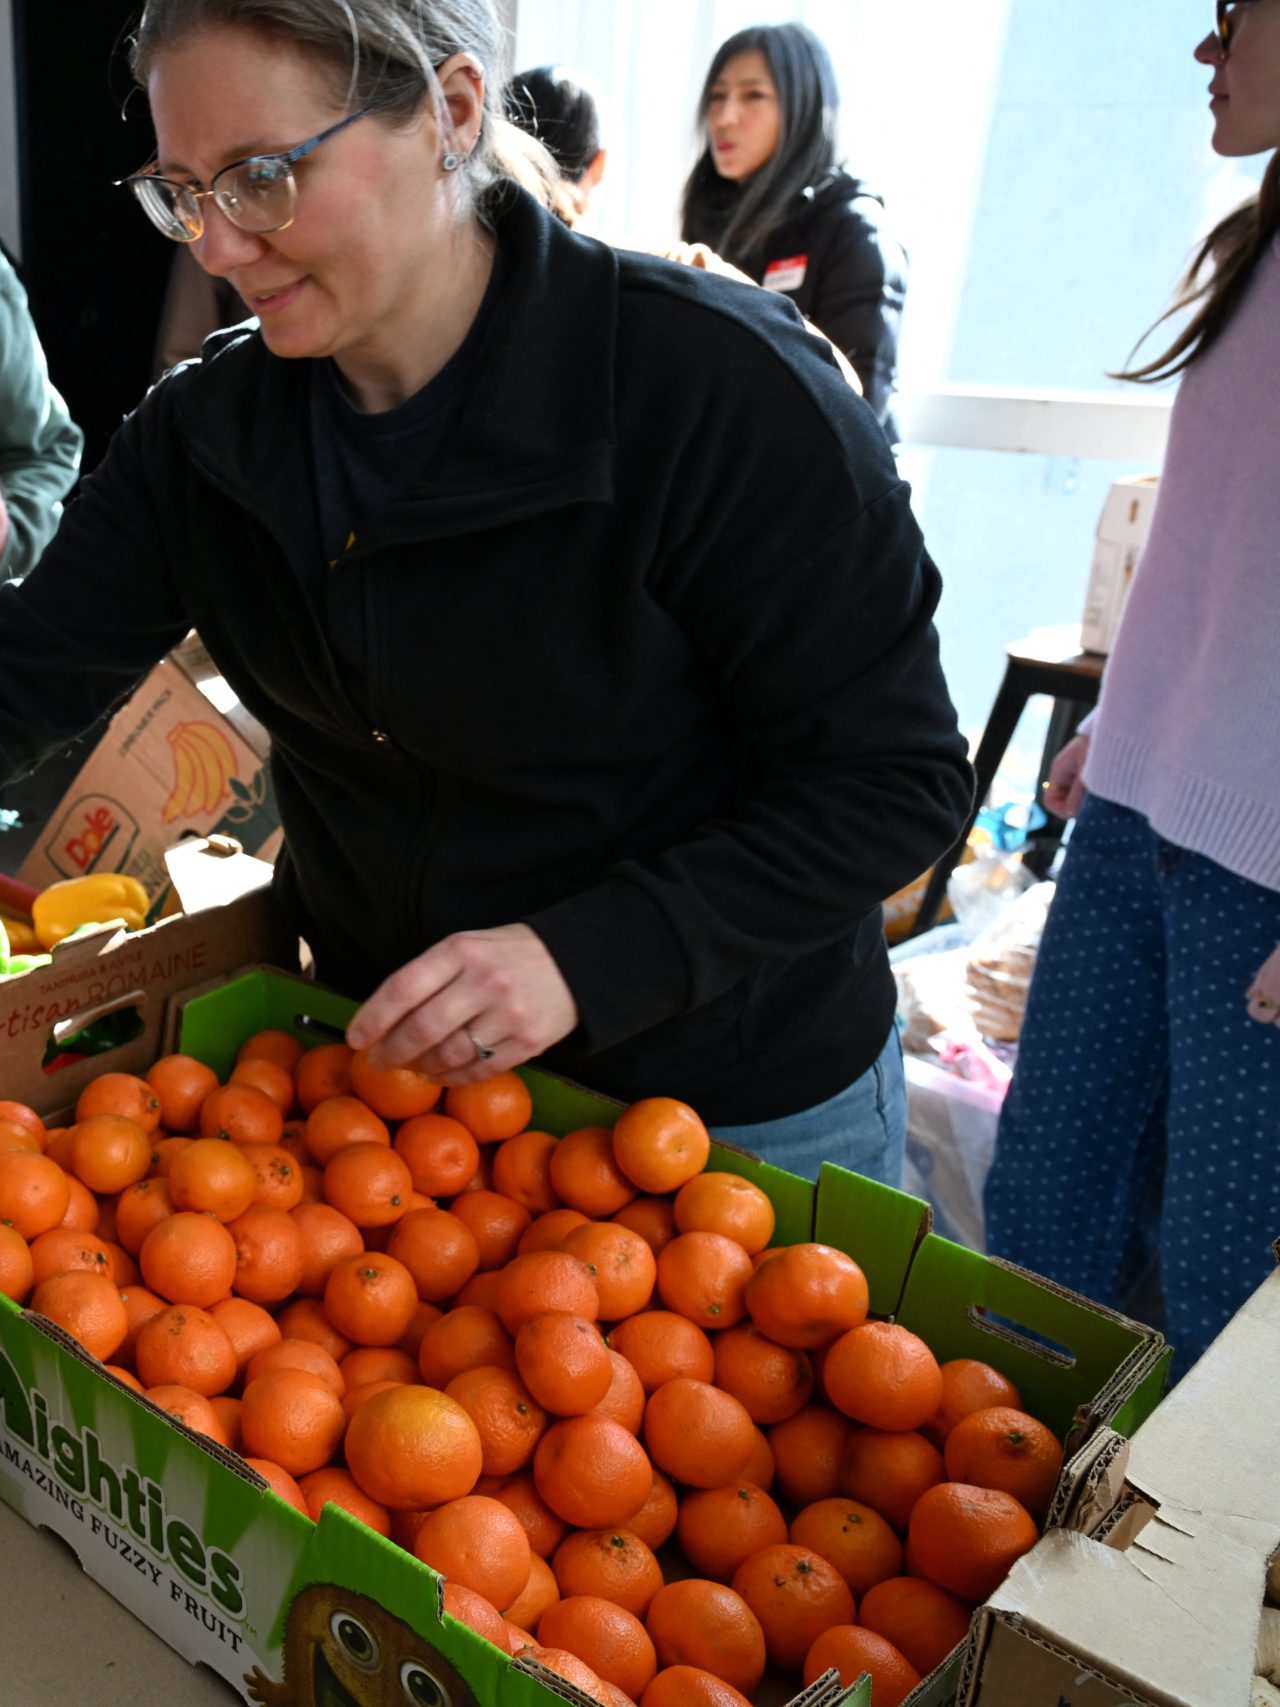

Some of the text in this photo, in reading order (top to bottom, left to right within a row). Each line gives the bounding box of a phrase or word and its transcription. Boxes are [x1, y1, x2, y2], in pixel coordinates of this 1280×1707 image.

[64, 807, 114, 869] Dole
[87, 942, 207, 1004] ROMAINE
[90, 1513, 162, 1586] FUZZY
[169, 1580, 243, 1653] FRUIT
